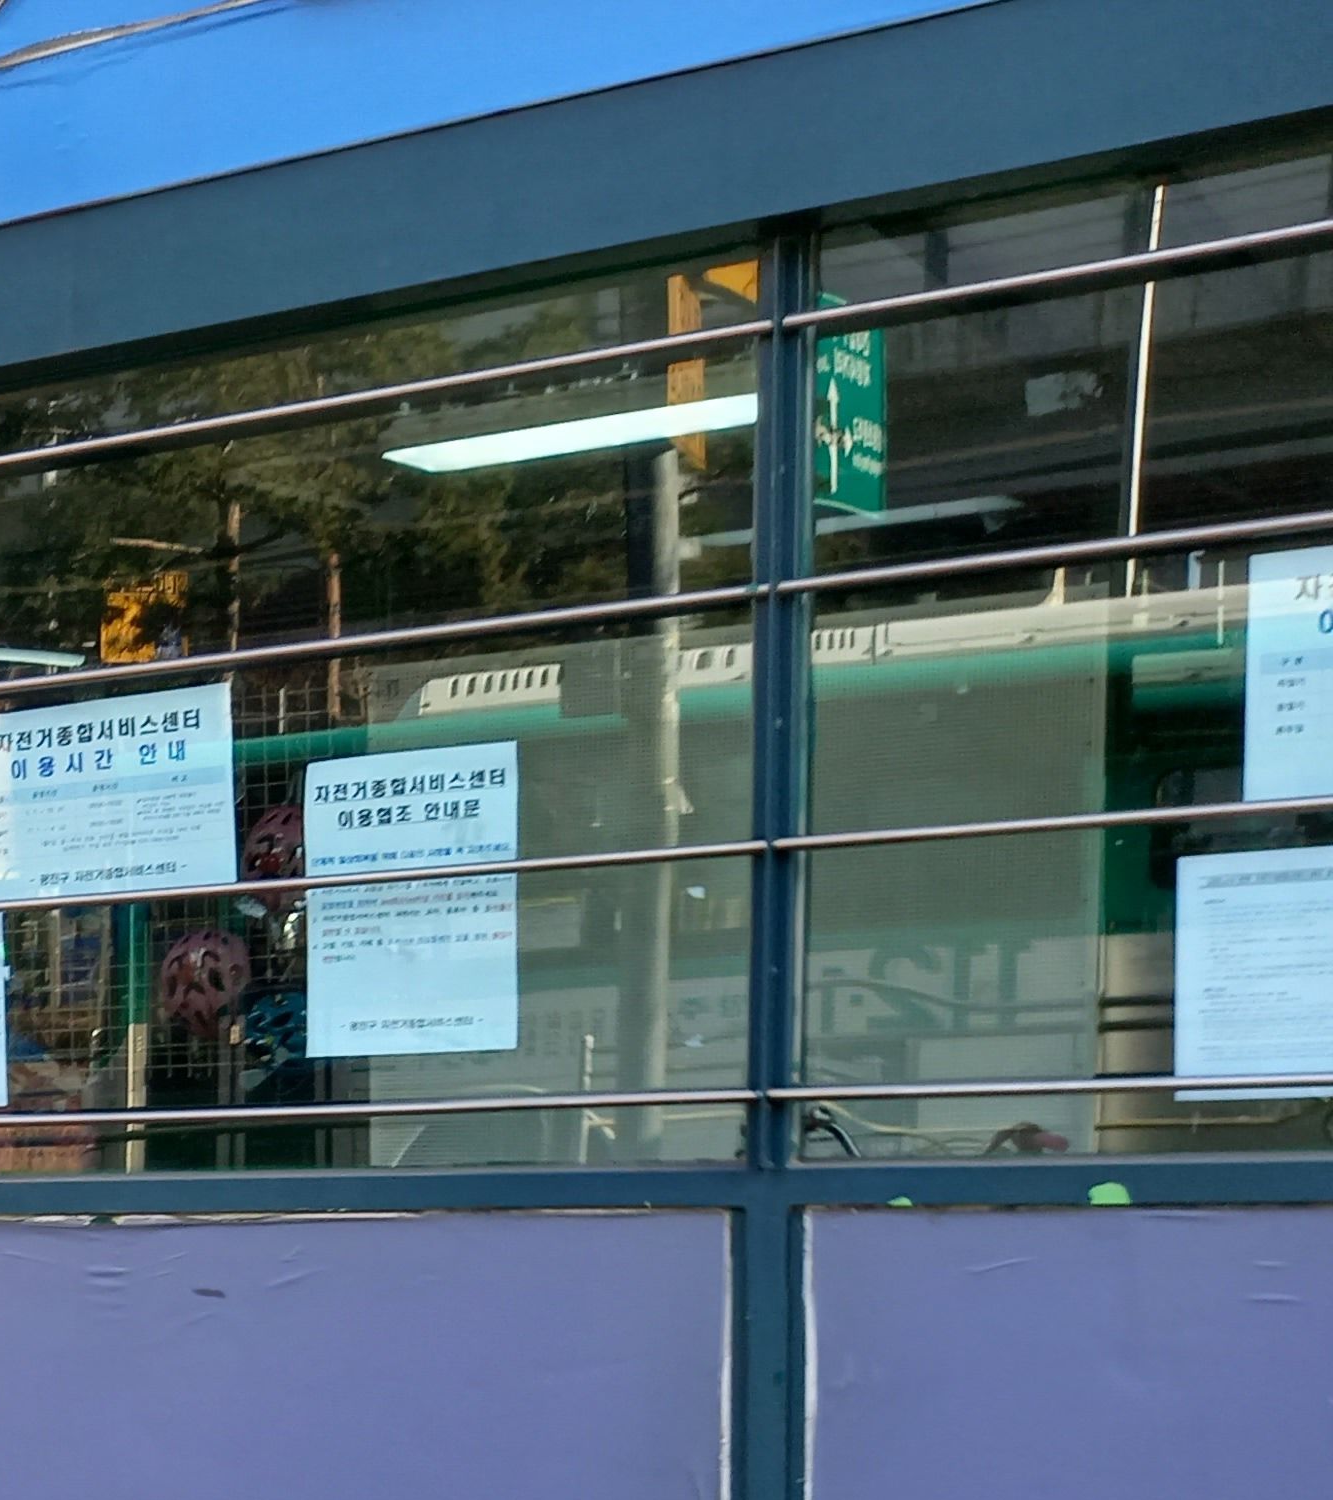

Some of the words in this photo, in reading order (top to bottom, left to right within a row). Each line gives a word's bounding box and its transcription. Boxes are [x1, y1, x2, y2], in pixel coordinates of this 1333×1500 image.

[314, 767, 506, 804] 자전거종합서비스센터
[338, 804, 413, 829] 이용협조
[423, 798, 481, 822] 안내문
